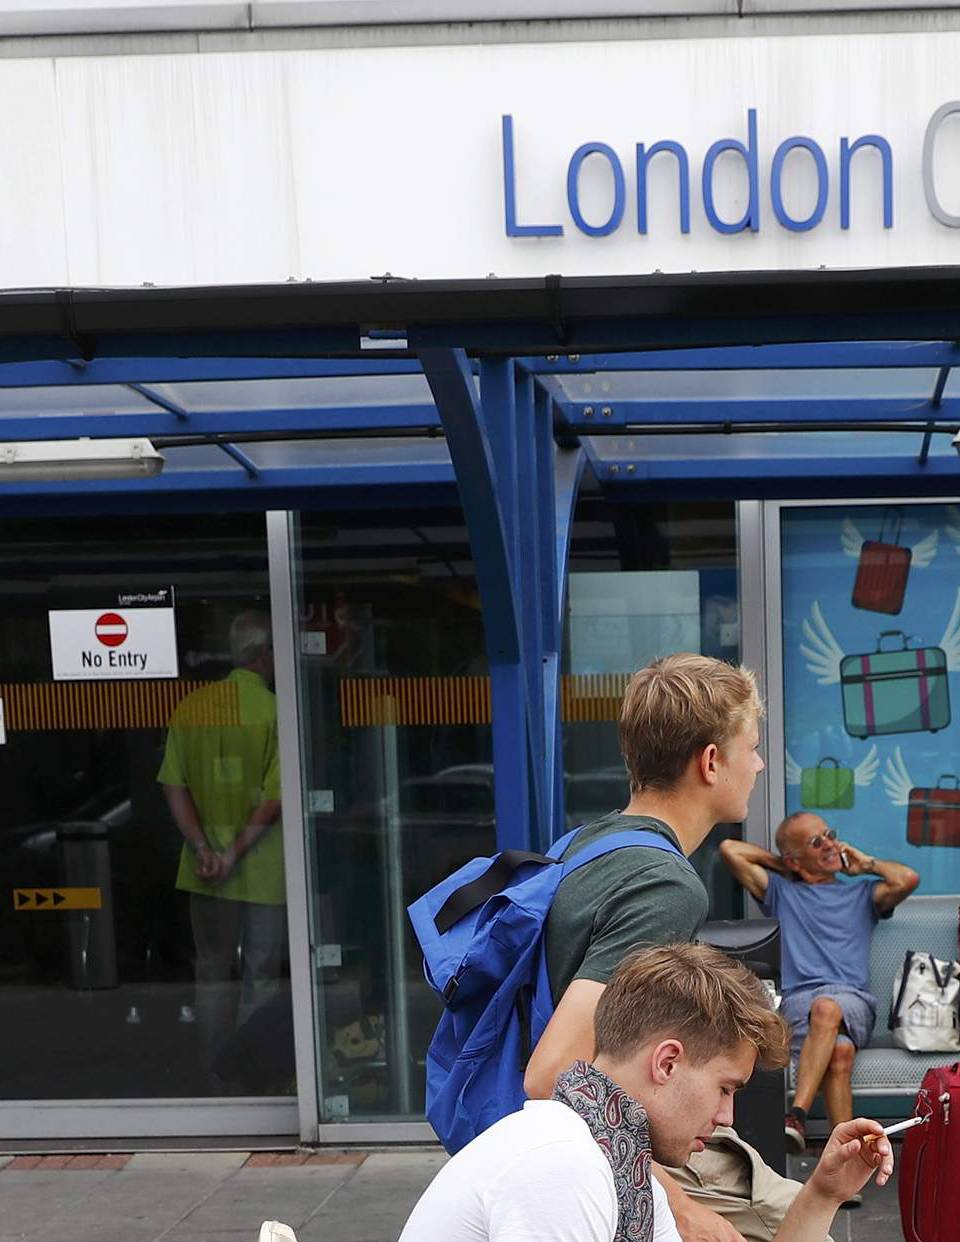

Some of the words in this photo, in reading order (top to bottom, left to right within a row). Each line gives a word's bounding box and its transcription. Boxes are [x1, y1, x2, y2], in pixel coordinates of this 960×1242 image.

[502, 108, 893, 238] London
[81, 650, 102, 668] No
[109, 650, 147, 671] Entry
